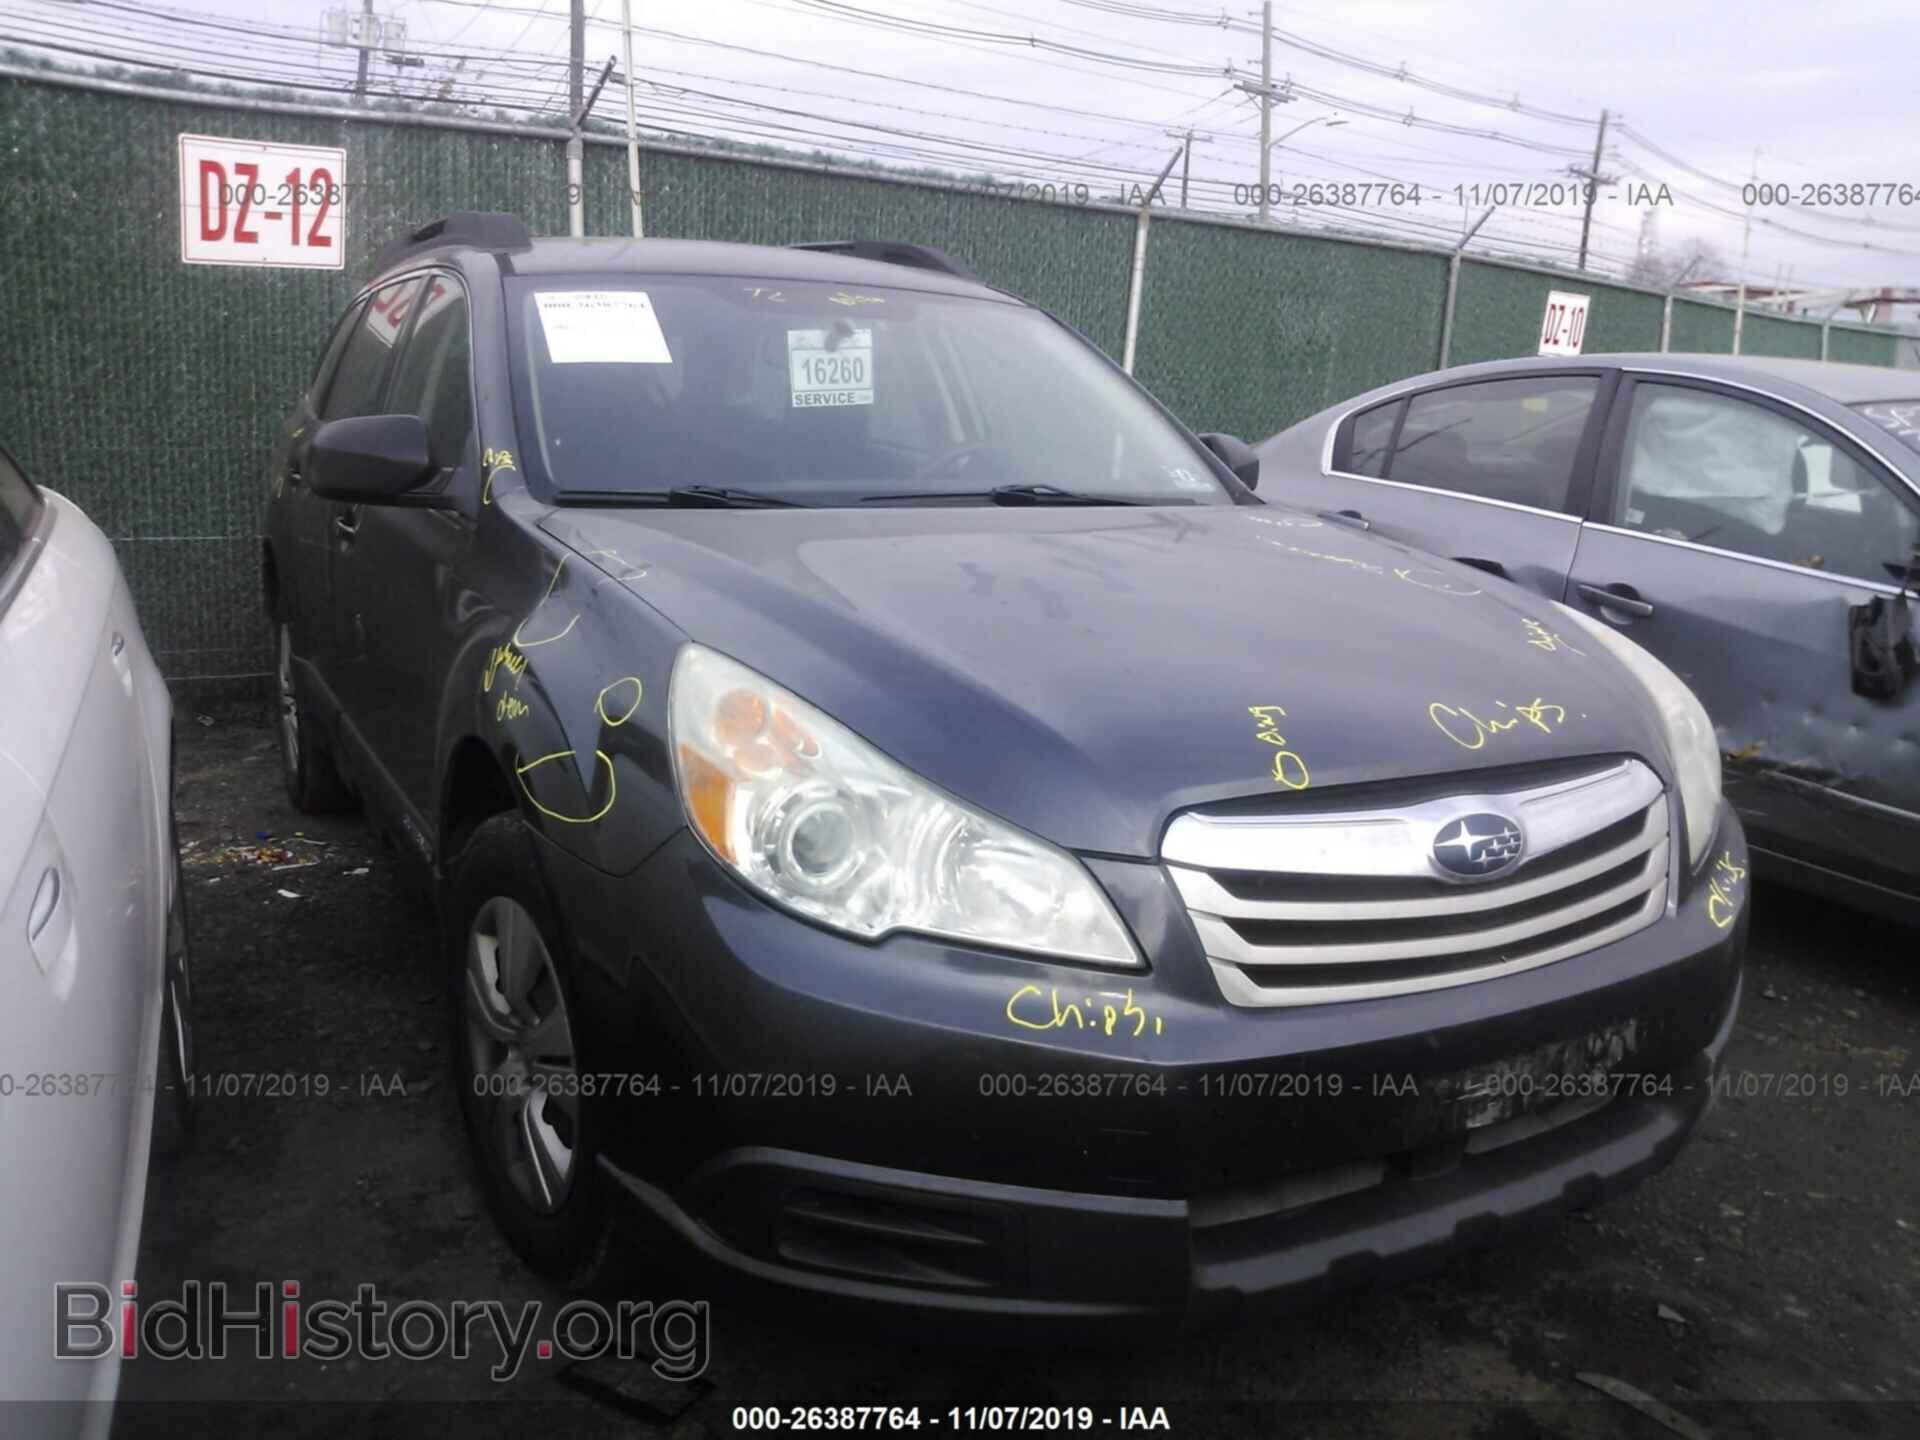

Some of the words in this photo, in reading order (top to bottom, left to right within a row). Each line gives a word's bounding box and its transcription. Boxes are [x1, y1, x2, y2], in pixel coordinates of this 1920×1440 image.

[199, 160, 332, 247] DZ-12
[1544, 304, 1584, 348] DZ-10
[801, 357, 864, 385] 16260
[794, 392, 856, 406] SERVICE
